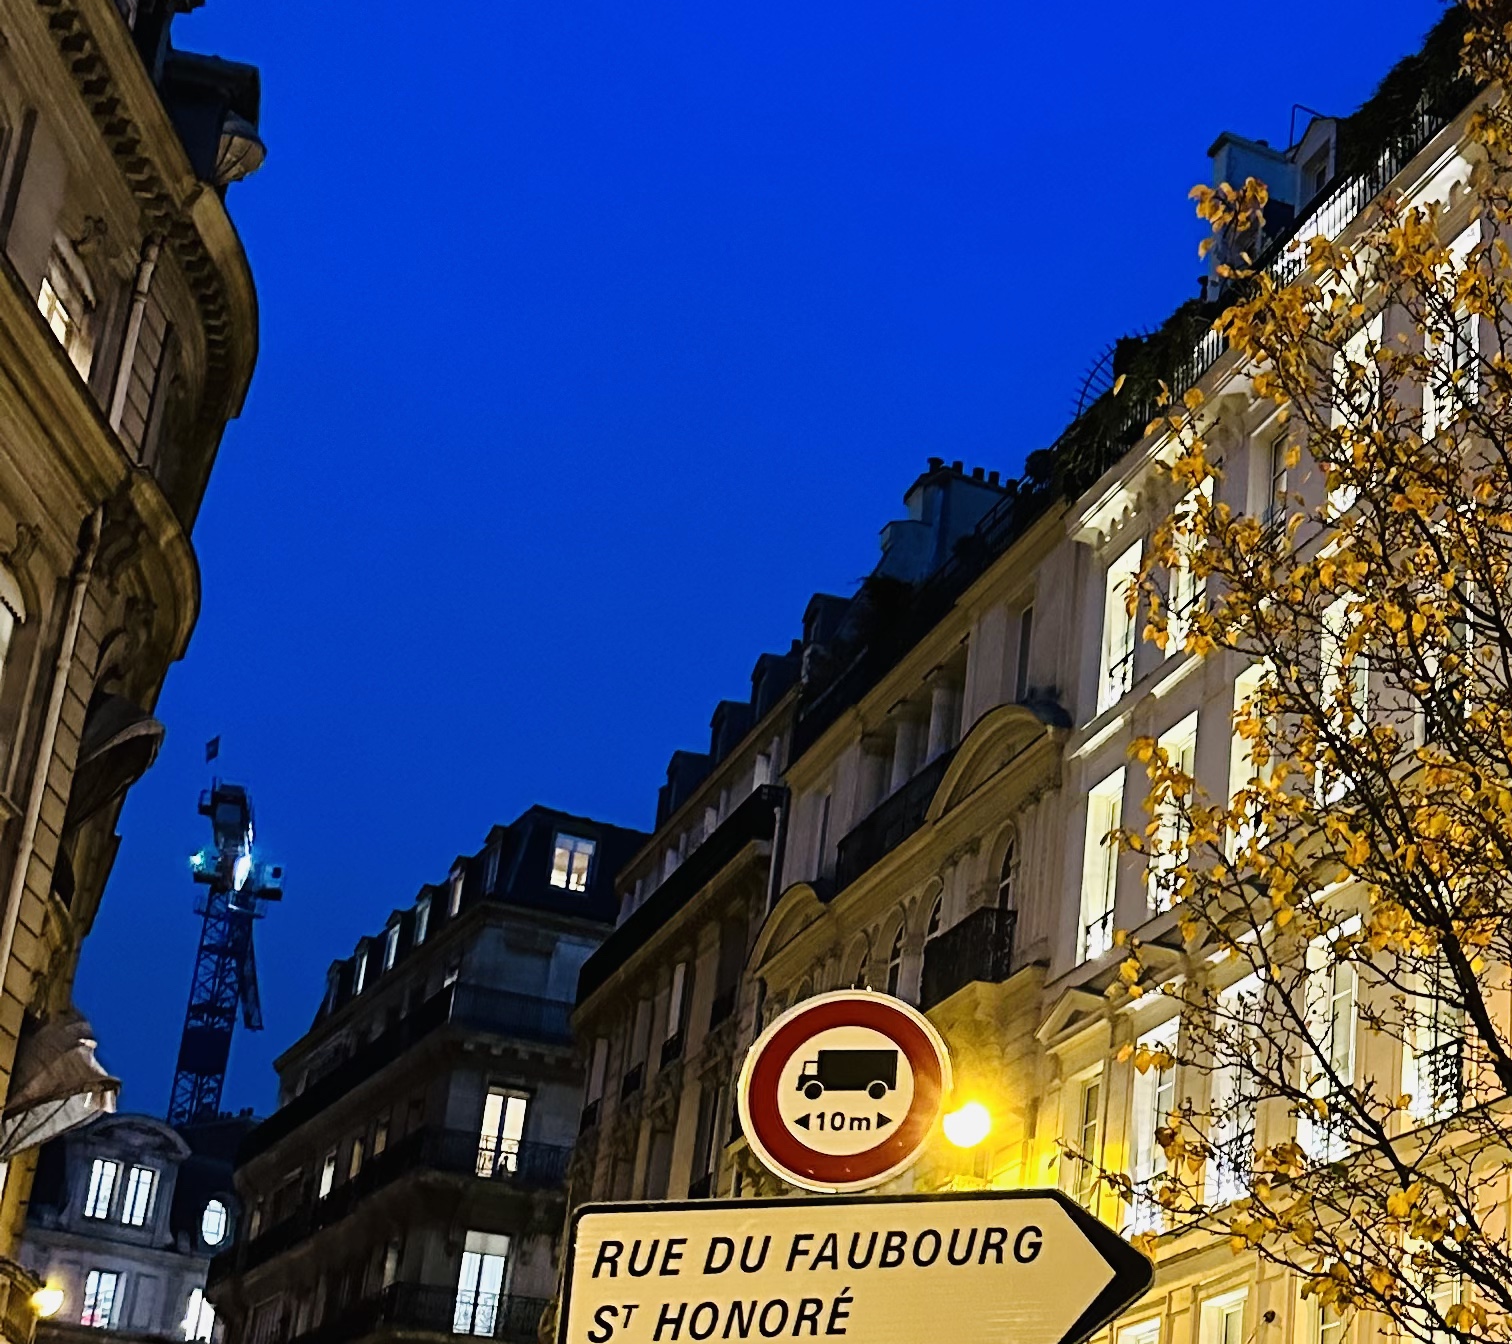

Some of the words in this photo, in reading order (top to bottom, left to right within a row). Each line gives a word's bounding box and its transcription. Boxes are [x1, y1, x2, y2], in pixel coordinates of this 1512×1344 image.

[817, 1112, 870, 1131] 10m
[592, 1238, 688, 1278] RUE
[703, 1235, 771, 1274] DU
[786, 1225, 1043, 1271] FAUBOURG
[652, 1287, 854, 1342] HONORÉ
